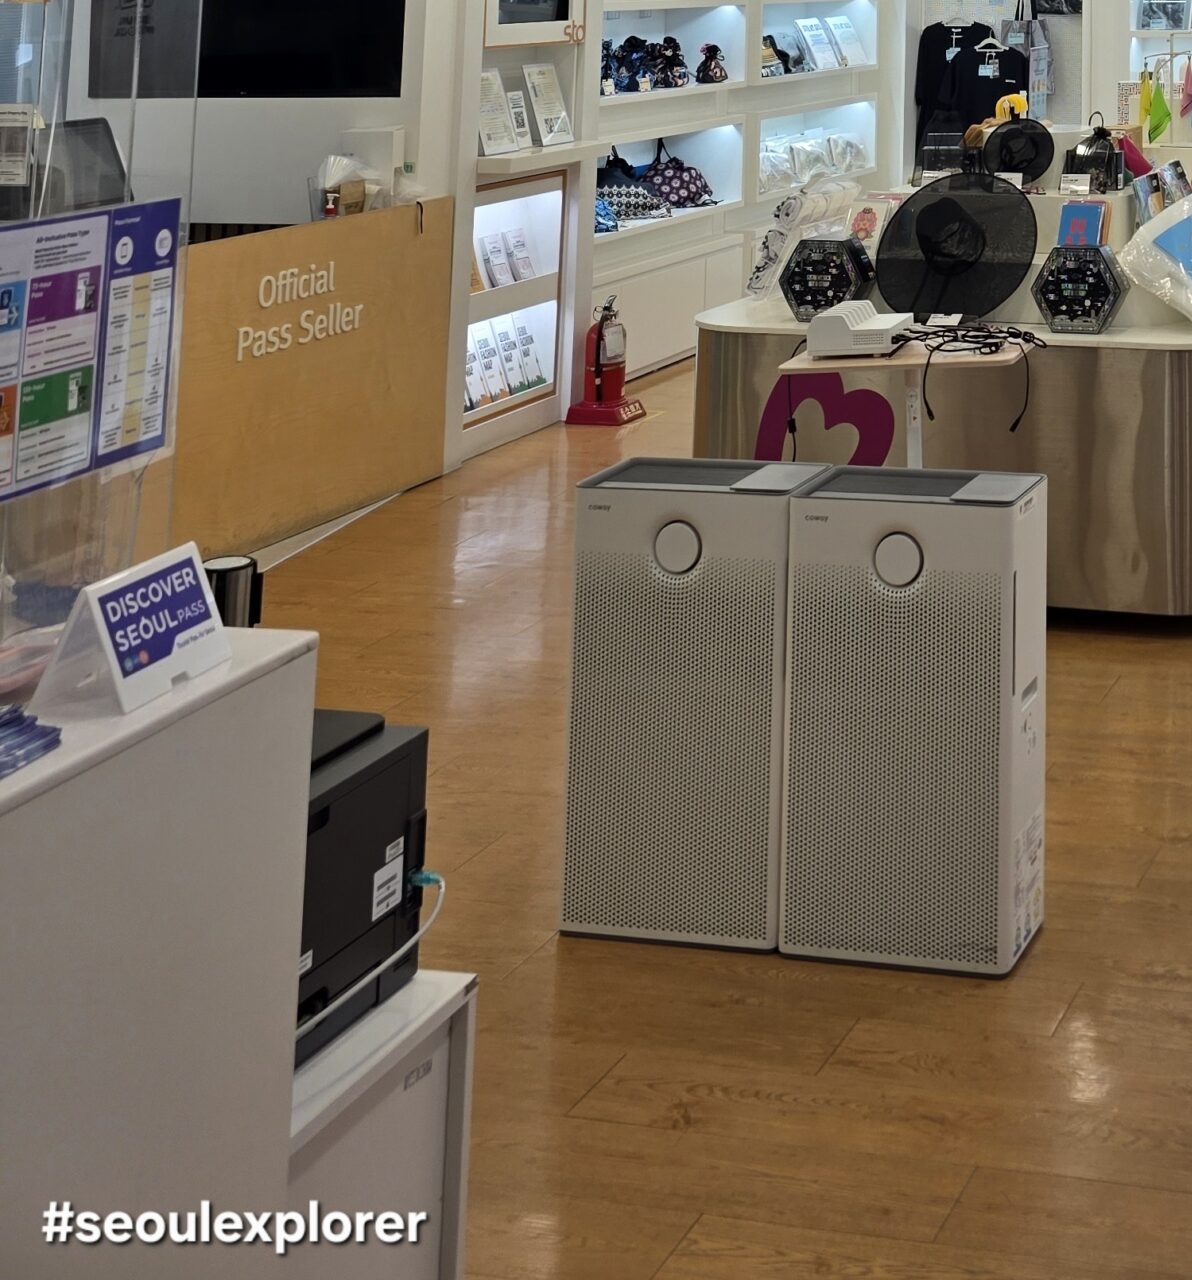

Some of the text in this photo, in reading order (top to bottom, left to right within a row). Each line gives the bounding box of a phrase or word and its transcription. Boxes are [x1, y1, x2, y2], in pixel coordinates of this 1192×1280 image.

[258, 261, 336, 309] Official
[237, 302, 365, 361] Pass Seller
[105, 567, 197, 623] DISCOVER
[115, 600, 206, 652] SEOUL PASS
